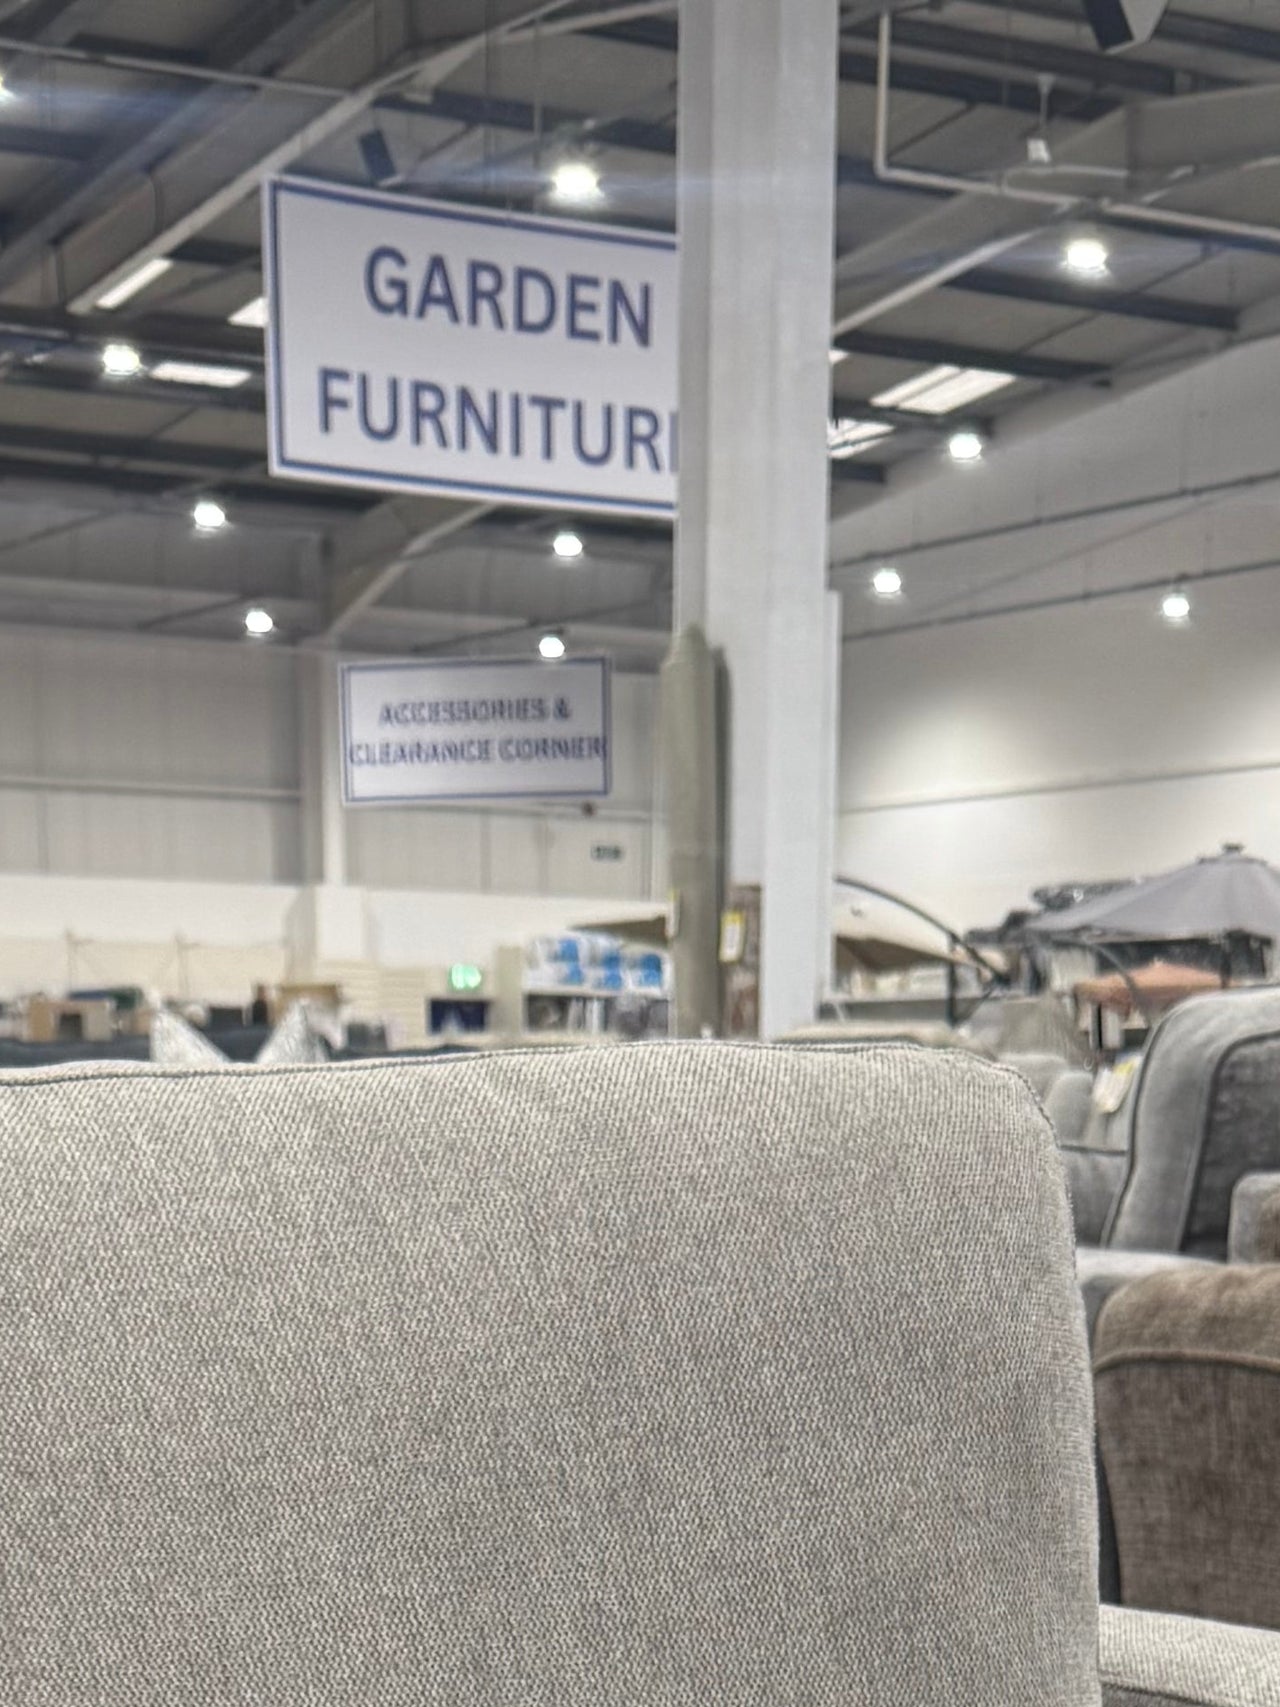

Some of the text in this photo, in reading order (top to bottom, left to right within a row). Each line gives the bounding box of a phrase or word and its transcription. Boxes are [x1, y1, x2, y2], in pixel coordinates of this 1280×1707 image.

[364, 245, 653, 348] GARDEN
[317, 366, 679, 474] FURNITUR
[553, 697, 572, 720] &
[349, 736, 607, 765] CLEARANCE CORNER
